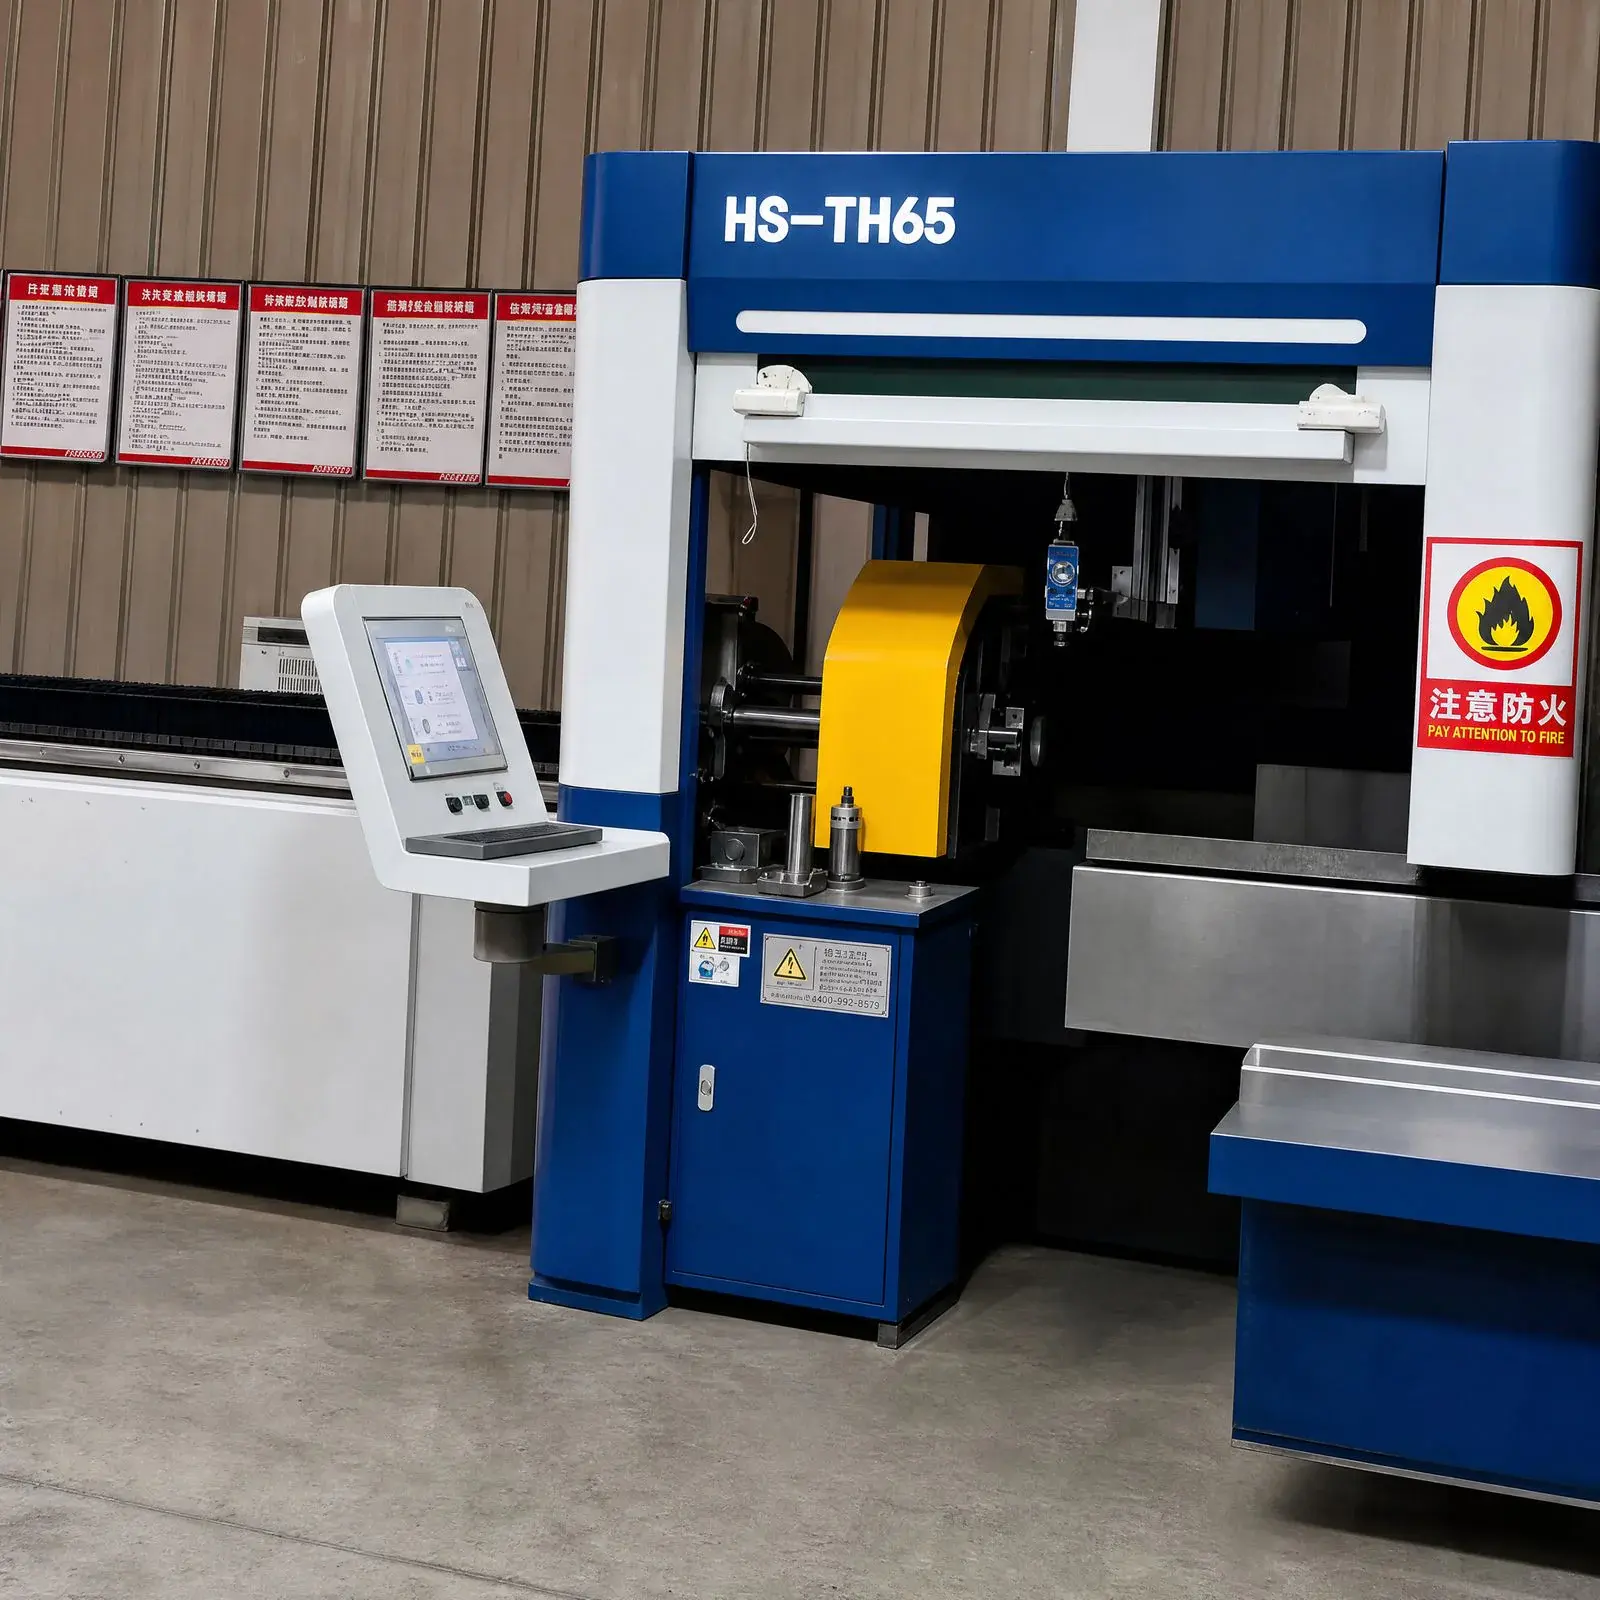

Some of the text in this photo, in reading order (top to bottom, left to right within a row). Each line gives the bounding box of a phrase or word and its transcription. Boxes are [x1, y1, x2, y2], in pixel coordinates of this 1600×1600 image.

[724, 195, 956, 245] HS-TH65
[1429, 688, 1567, 726] 注意防火
[1428, 724, 1565, 745] PAY ATTENTION TO FIRE
